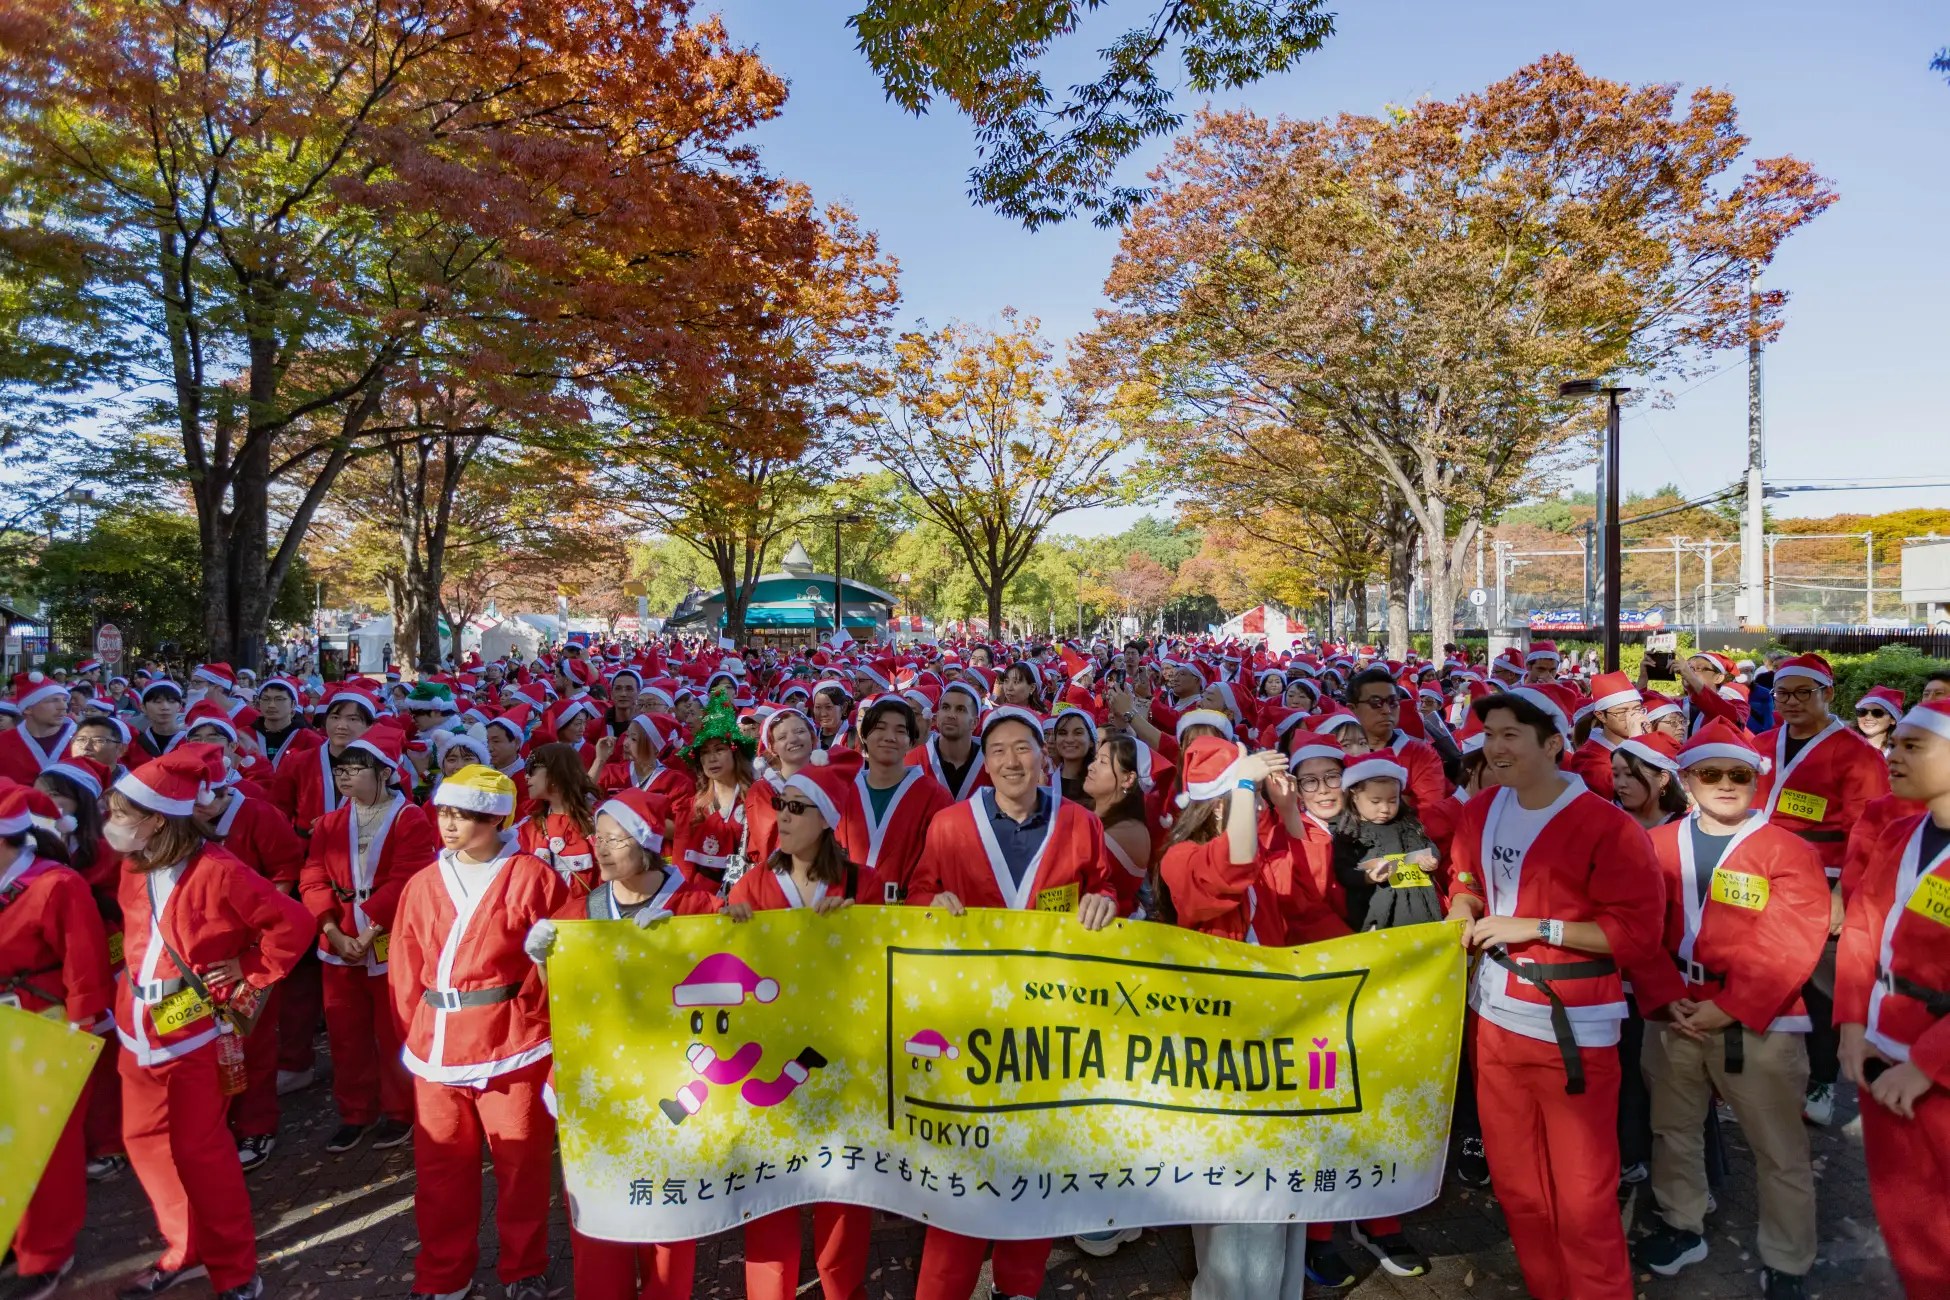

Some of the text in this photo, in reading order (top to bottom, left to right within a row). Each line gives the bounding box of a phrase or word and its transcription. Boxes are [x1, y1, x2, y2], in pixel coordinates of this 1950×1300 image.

[1787, 802, 1814, 815] 1039
[1723, 887, 1761, 904] 1047
[166, 1003, 203, 1025] 0026
[1024, 981, 1109, 1007] seven
[1145, 992, 1232, 1017] seven
[966, 1025, 1298, 1092] SANTA PARADE
[904, 1113, 990, 1149] TOKYO
[628, 1145, 1398, 1206] 病気とたたかう子どもたちへクリスマスプレゼントを贈ろう!
